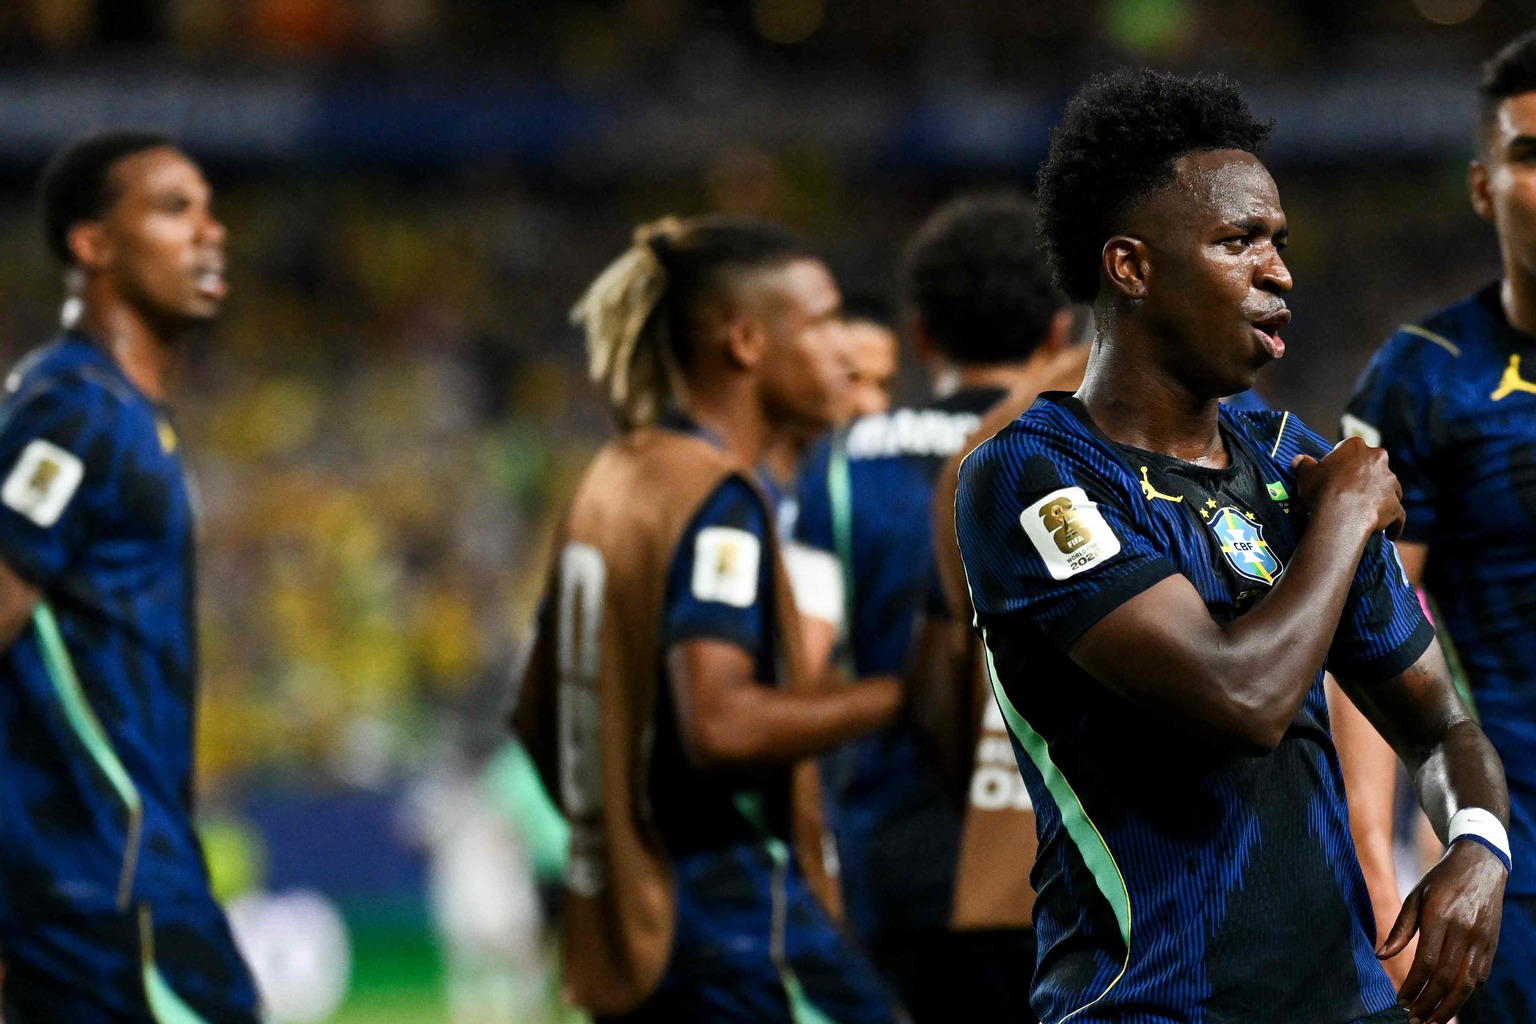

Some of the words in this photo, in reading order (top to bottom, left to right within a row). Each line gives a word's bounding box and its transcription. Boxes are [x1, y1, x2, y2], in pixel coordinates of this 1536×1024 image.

[1067, 535, 1085, 549] FIFA
[1233, 542, 1253, 551] CBF
[1066, 549, 1087, 564] WORLD
